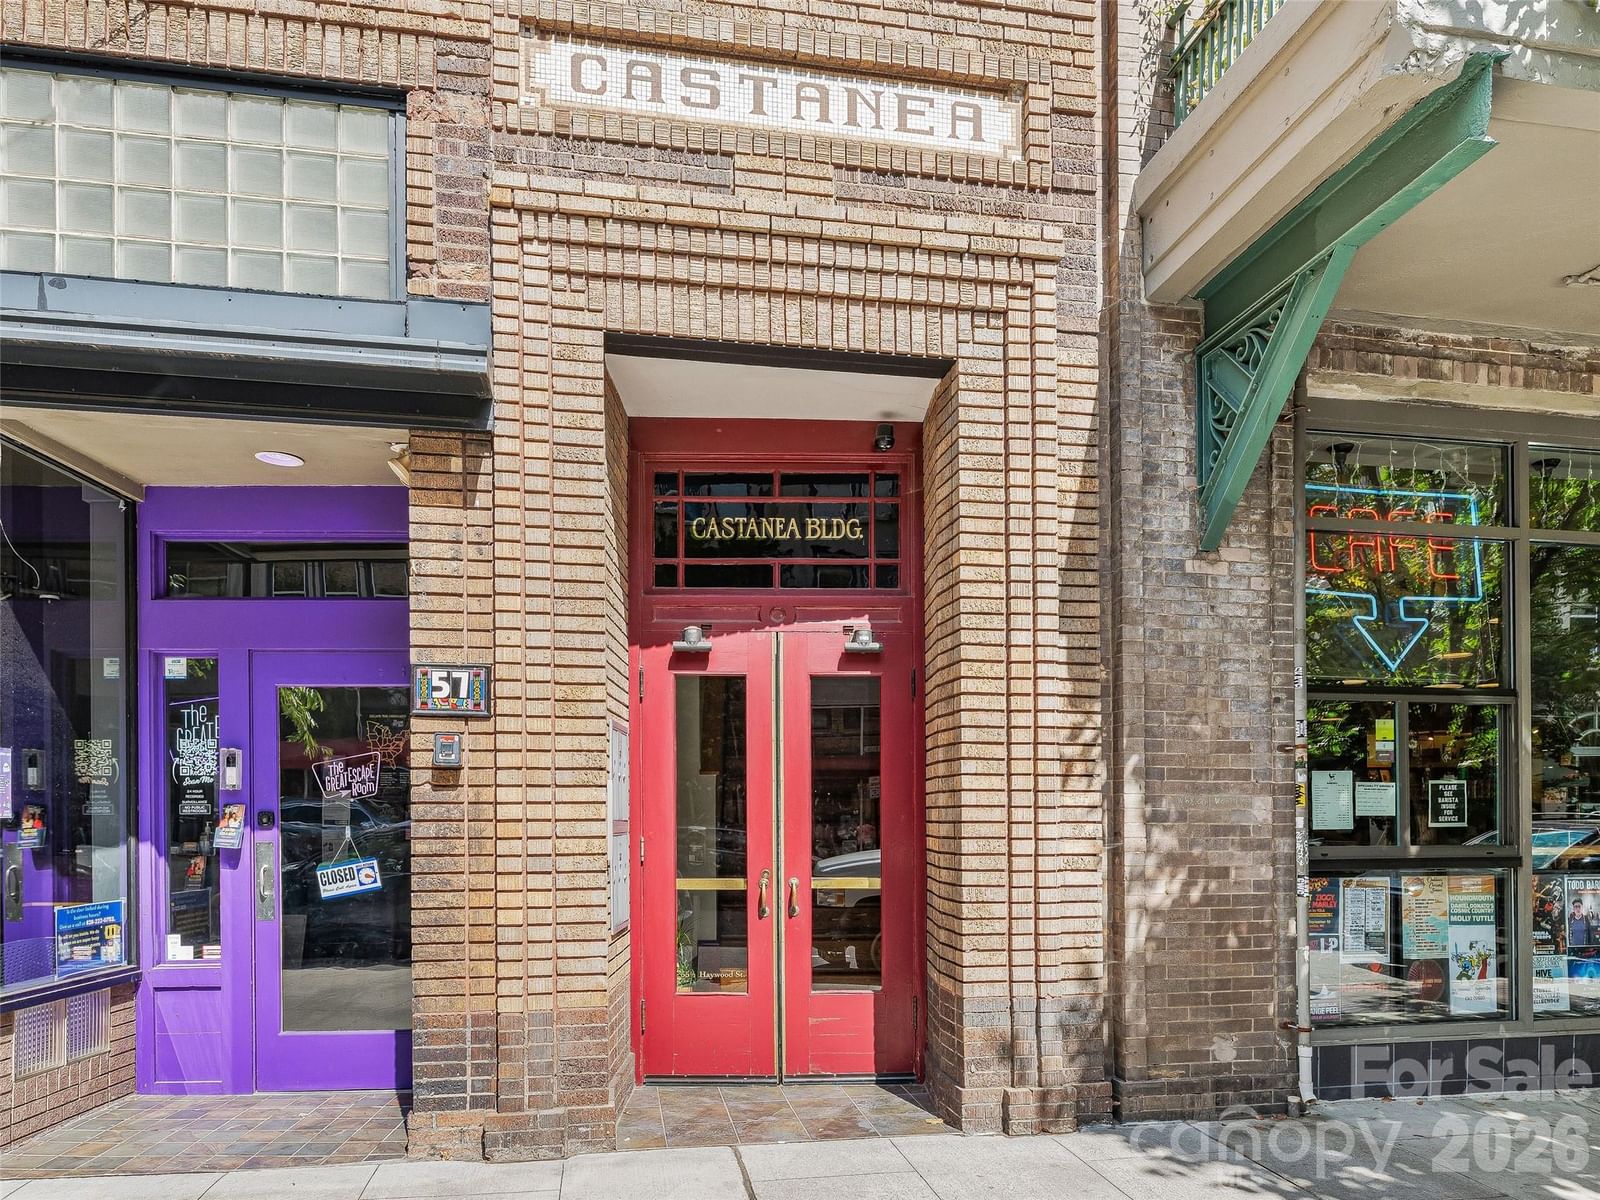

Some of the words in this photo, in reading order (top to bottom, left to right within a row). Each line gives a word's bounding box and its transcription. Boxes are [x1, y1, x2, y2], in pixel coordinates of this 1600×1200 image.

[572, 52, 987, 143] CASTANEA
[692, 517, 801, 539] CASTANEA
[805, 518, 864, 540] BLDG.
[1310, 505, 1461, 580] CAFE
[431, 671, 470, 699] 57
[325, 772, 349, 792] GREAT
[347, 764, 375, 783] ESCAPE
[328, 761, 344, 777] The
[319, 866, 356, 887] CLOSED
[699, 971, 734, 979] Haywood
[1535, 968, 1552, 977] HIVE
